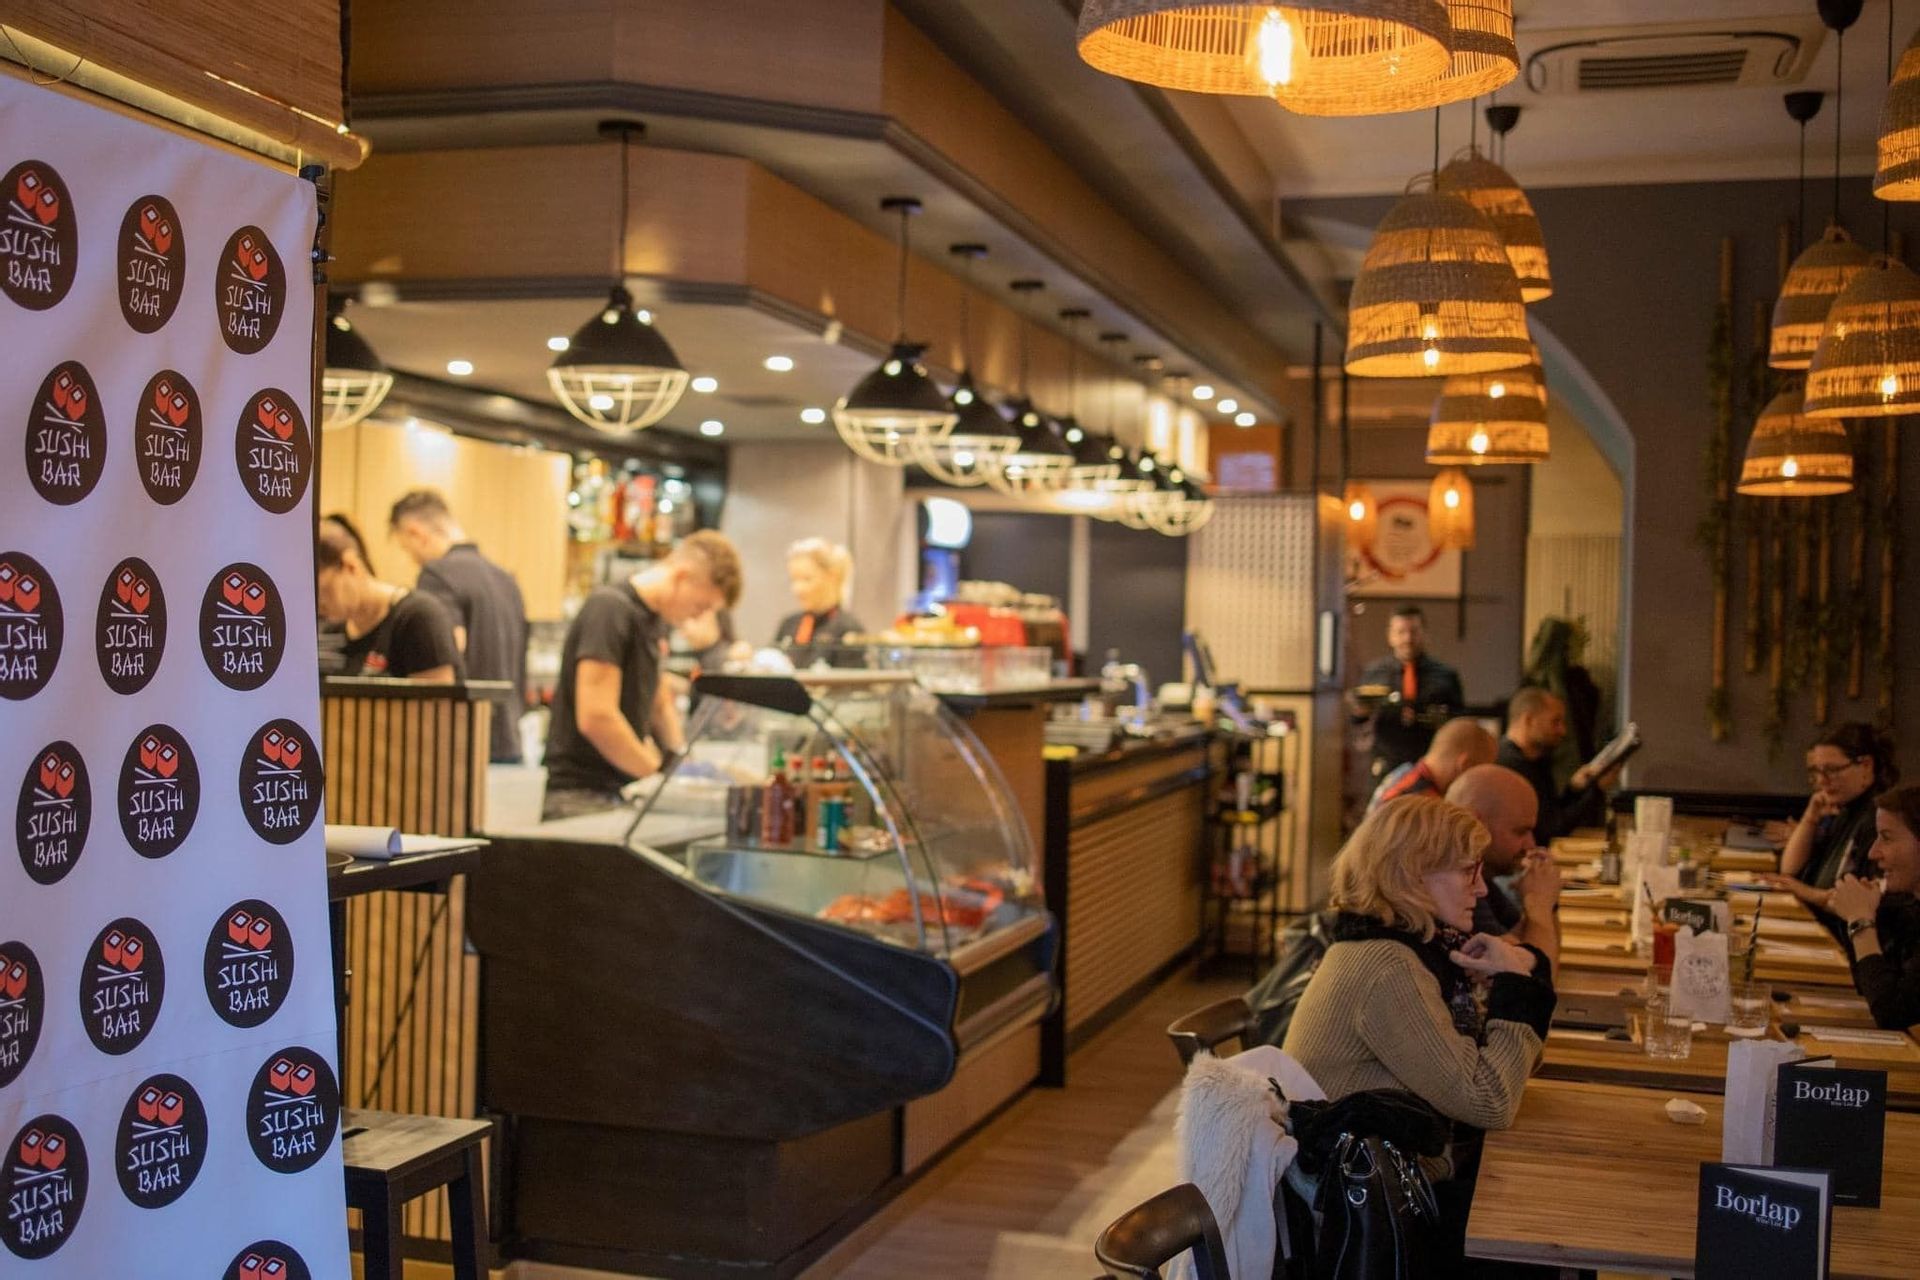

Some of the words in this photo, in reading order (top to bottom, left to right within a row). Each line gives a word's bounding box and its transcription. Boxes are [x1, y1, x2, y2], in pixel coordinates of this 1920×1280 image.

[0, 229, 60, 265] SUSHI
[8, 260, 52, 293] BAR
[126, 259, 171, 292] SUSHI
[129, 288, 160, 317] BAR
[225, 285, 271, 315] SUSHI
[227, 313, 260, 339] BAR
[34, 429, 90, 459] SUSHI
[144, 434, 190, 462] SUSHI
[41, 460, 81, 487] BAR
[249, 448, 299, 474] SUSHI
[150, 463, 181, 488] BAR
[258, 473, 293, 498] BAR
[0, 624, 47, 650] USHI
[104, 625, 153, 649] SUSHI
[212, 625, 272, 648] SUSHI
[111, 652, 144, 677] BAR
[223, 651, 264, 674] BAR
[129, 788, 184, 816] SUSHI
[253, 779, 308, 804] SUSHI
[27, 807, 77, 839] SUSHI
[138, 815, 175, 842] BAR
[262, 805, 300, 829] BAR
[34, 839, 68, 868] BAR
[218, 959, 278, 989] SUSHI
[93, 981, 149, 1014] SUSHI
[229, 987, 270, 1013] BAR
[0, 1008, 29, 1038] SHI
[102, 1010, 140, 1039] BAR
[0, 1040, 19, 1067] AR
[1794, 1080, 1870, 1108] Borlap
[260, 1103, 324, 1136] SUSHI
[127, 1134, 190, 1171] SUSHI
[272, 1132, 317, 1159] BAR
[137, 1163, 181, 1194] BAR
[8, 1179, 73, 1220] SUSHI
[1714, 1184, 1800, 1230] Borlap
[19, 1213, 64, 1246] BAR
